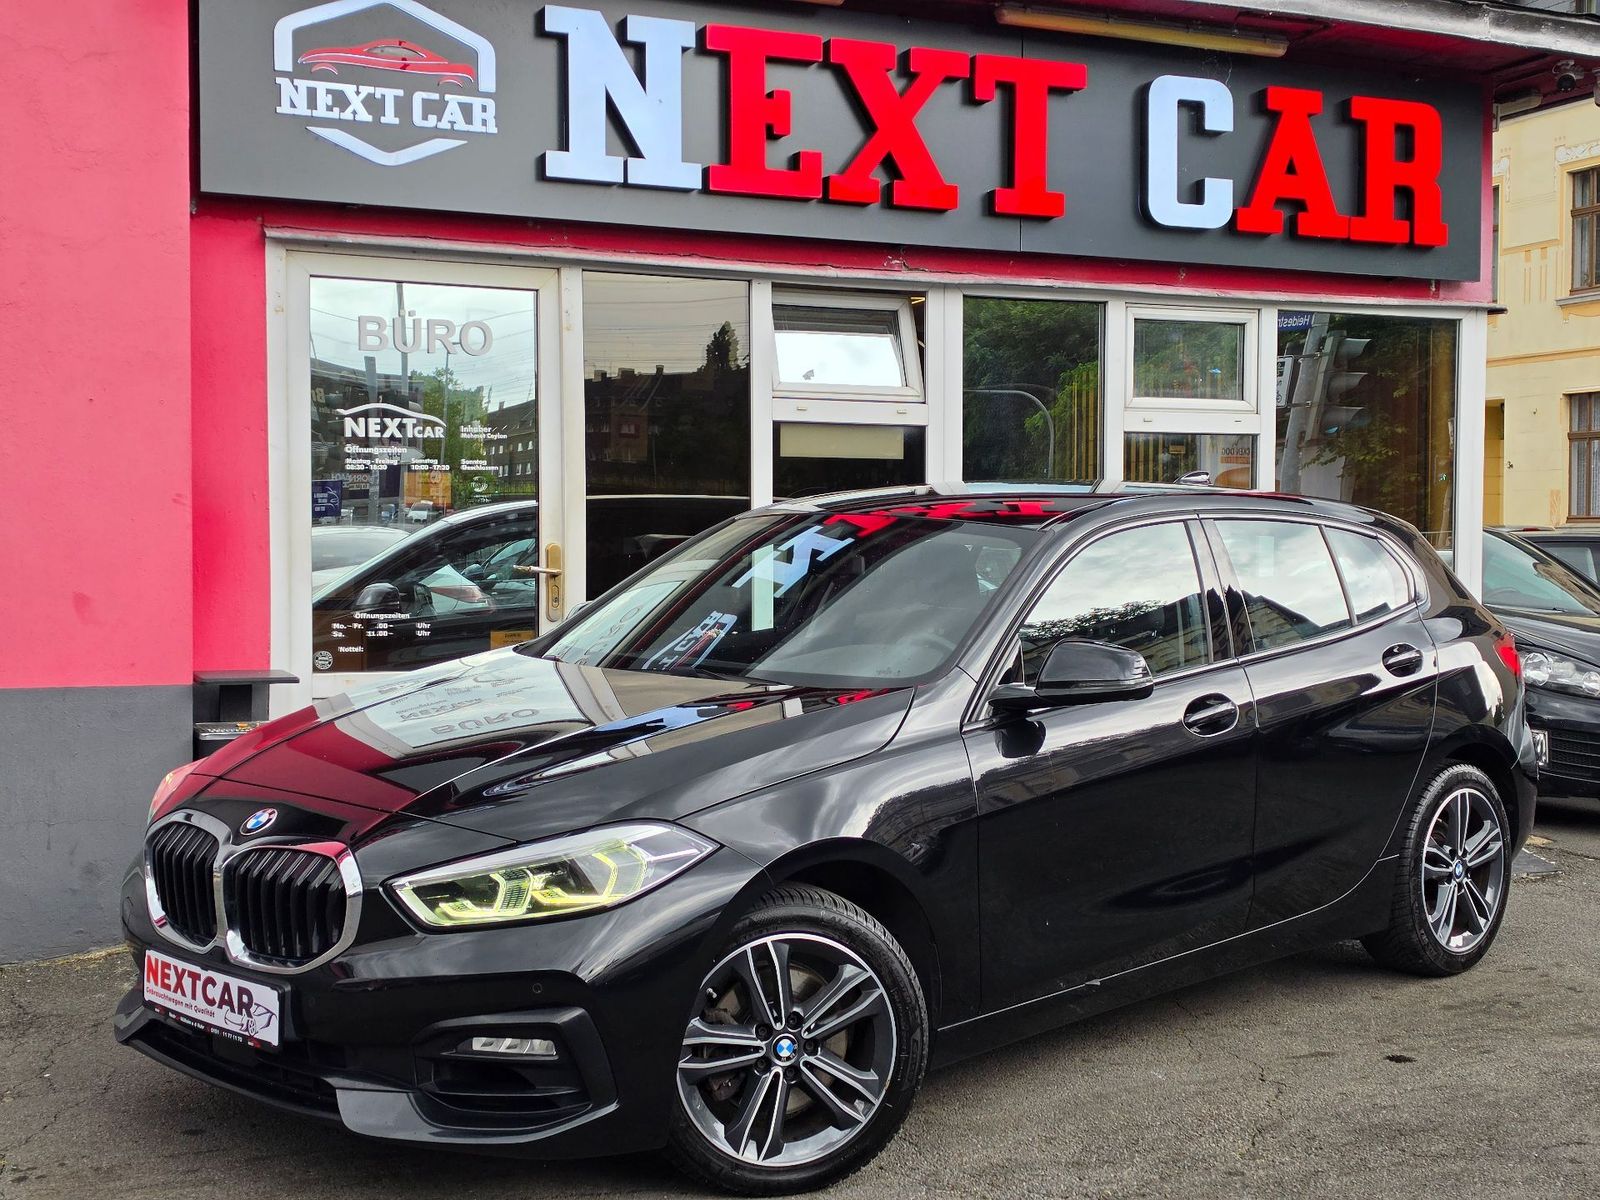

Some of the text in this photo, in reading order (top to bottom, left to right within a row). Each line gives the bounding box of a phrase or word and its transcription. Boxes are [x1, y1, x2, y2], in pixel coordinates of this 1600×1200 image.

[274, 77, 499, 135] NEXT CAR
[543, 4, 1449, 248] NEXT CAR
[357, 309, 494, 357] BÜRO
[459, 425, 492, 433] Inhaber
[344, 443, 408, 455] Öffnungszeiten
[344, 457, 371, 465] Montag
[375, 457, 398, 466] Freitag
[410, 457, 438, 465] Samstag
[460, 458, 487, 466] Sonntag
[353, 612, 410, 620] Öffnungszeiten
[146, 954, 254, 1019] NEXTCAR
[184, 1002, 193, 1010] mit
[193, 1005, 215, 1018] Qualität
